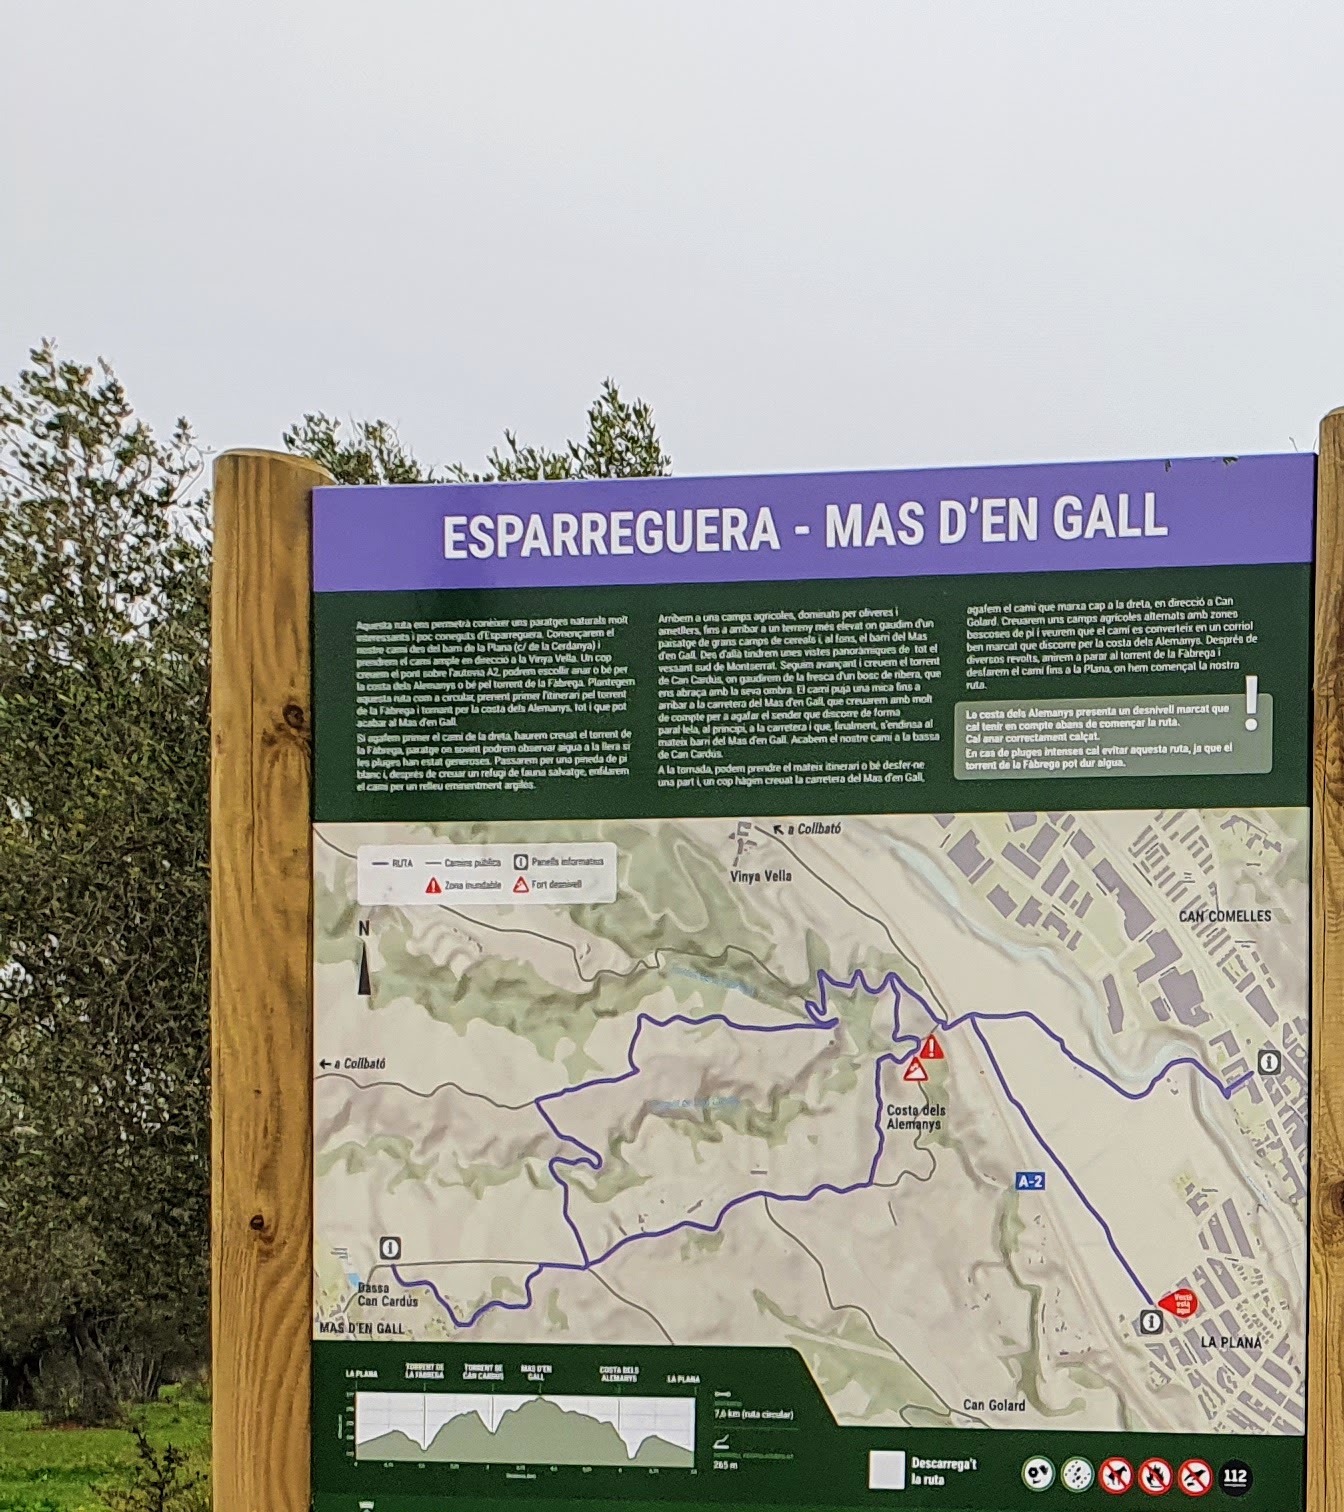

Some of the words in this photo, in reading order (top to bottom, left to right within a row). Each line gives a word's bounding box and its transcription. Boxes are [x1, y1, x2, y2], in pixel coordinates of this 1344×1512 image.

[443, 507, 780, 560] ESPARREGUERA
[824, 502, 926, 548] MAS
[939, 496, 1039, 545] D'EN
[1053, 492, 1168, 540] GALL
[966, 604, 1001, 615] agafem
[1003, 603, 1011, 612] el
[1037, 603, 1055, 613] que
[1057, 602, 1086, 610] marxa
[1088, 602, 1105, 611] cap
[1115, 599, 1124, 609] la
[1214, 596, 1233, 605] Can
[1001, 615, 1045, 625] Creuarem
[1066, 615, 1097, 624] camps
[1187, 609, 1208, 619] amb
[1012, 628, 1024, 637] de
[1025, 628, 1034, 639] pi
[1041, 628, 1075, 636] veurem
[1077, 627, 1095, 637] que
[1096, 625, 1105, 635] el
[1209, 623, 1221, 631] un
[1223, 621, 1253, 630] corriol
[966, 642, 983, 651] ben
[985, 641, 1017, 651] marcat
[1019, 642, 1037, 651] que
[1038, 639, 1076, 649] discorre
[1078, 640, 1093, 650] per
[1095, 638, 1104, 647] la
[1105, 637, 1131, 647] costa
[1133, 637, 1153, 646] dels
[1245, 633, 1257, 643] de
[1083, 652, 1107, 662] parar
[1109, 650, 1118, 659] al
[1120, 649, 1151, 659] torrent
[1153, 649, 1165, 658] de
[1167, 649, 1175, 658] la
[966, 666, 1009, 676] desfarem
[1011, 666, 1019, 675] el
[1046, 665, 1063, 674] fins
[1073, 664, 1081, 673] la
[1113, 664, 1126, 672] on
[1127, 662, 1148, 672] hem
[1150, 661, 1196, 673] començat
[1198, 660, 1207, 670] la
[1209, 660, 1239, 669] nostra
[965, 710, 977, 719] La
[979, 709, 1005, 718] costa
[1006, 708, 1026, 718] dels
[1028, 707, 1074, 719] Alemanys
[1075, 706, 1116, 718] presenta
[1118, 707, 1130, 715] un
[1132, 704, 1174, 714] desnivell
[1176, 703, 1209, 713] marcat
[1211, 704, 1229, 714] que
[965, 722, 980, 731] cal
[981, 721, 1003, 730] tenir
[1004, 722, 1017, 730] en
[1018, 720, 1053, 731] compte
[1085, 719, 1097, 728] de
[1099, 719, 1145, 729] començar
[1147, 717, 1156, 726] la
[965, 734, 981, 743] Cal
[1005, 732, 1067, 742] correctament
[658, 749, 669, 758] de
[670, 749, 688, 758] Can
[965, 748, 977, 757] En
[997, 747, 1009, 756] de
[1011, 747, 1042, 758] pluges
[1085, 745, 1099, 754] cal
[1101, 745, 1128, 754] evitar
[1130, 744, 1167, 755] aquesta
[1193, 743, 1202, 754] ja
[1203, 744, 1222, 753] que
[1223, 742, 1232, 751] el
[965, 760, 997, 769] torrent
[998, 760, 1010, 769] de
[1012, 759, 1021, 768] la
[1062, 758, 1077, 769] pot
[1079, 758, 1095, 767] dur
[788, 825, 794, 834] a
[798, 822, 842, 834] Collbató
[392, 859, 413, 868] RUTA
[730, 871, 761, 884] Vinya
[765, 870, 792, 881] Vella
[445, 881, 464, 890] Zona
[532, 880, 548, 889] Fort
[1179, 910, 1204, 922] CAN
[1208, 910, 1272, 922] COMELLES
[359, 920, 370, 936] N
[334, 1061, 341, 1069] a
[344, 1057, 386, 1069] Collbató
[887, 1104, 918, 1116] Costa
[922, 1104, 946, 1116] dels
[887, 1118, 941, 1133] Alemanys
[1018, 1176, 1043, 1188] A-2
[358, 1295, 378, 1307] Can
[381, 1294, 418, 1307] Cardús
[320, 1322, 345, 1334] MAS
[348, 1322, 373, 1334] D'EN
[377, 1323, 405, 1335] GALL
[1201, 1336, 1217, 1348] LA
[1221, 1337, 1262, 1349] PLANA
[963, 1399, 985, 1411] Can
[989, 1399, 1026, 1411] Golard
[727, 1409, 741, 1418] km
[911, 1456, 978, 1472] Descarrega't
[911, 1473, 922, 1485] la
[923, 1474, 945, 1485] ruta
[1223, 1469, 1247, 1482] 112
